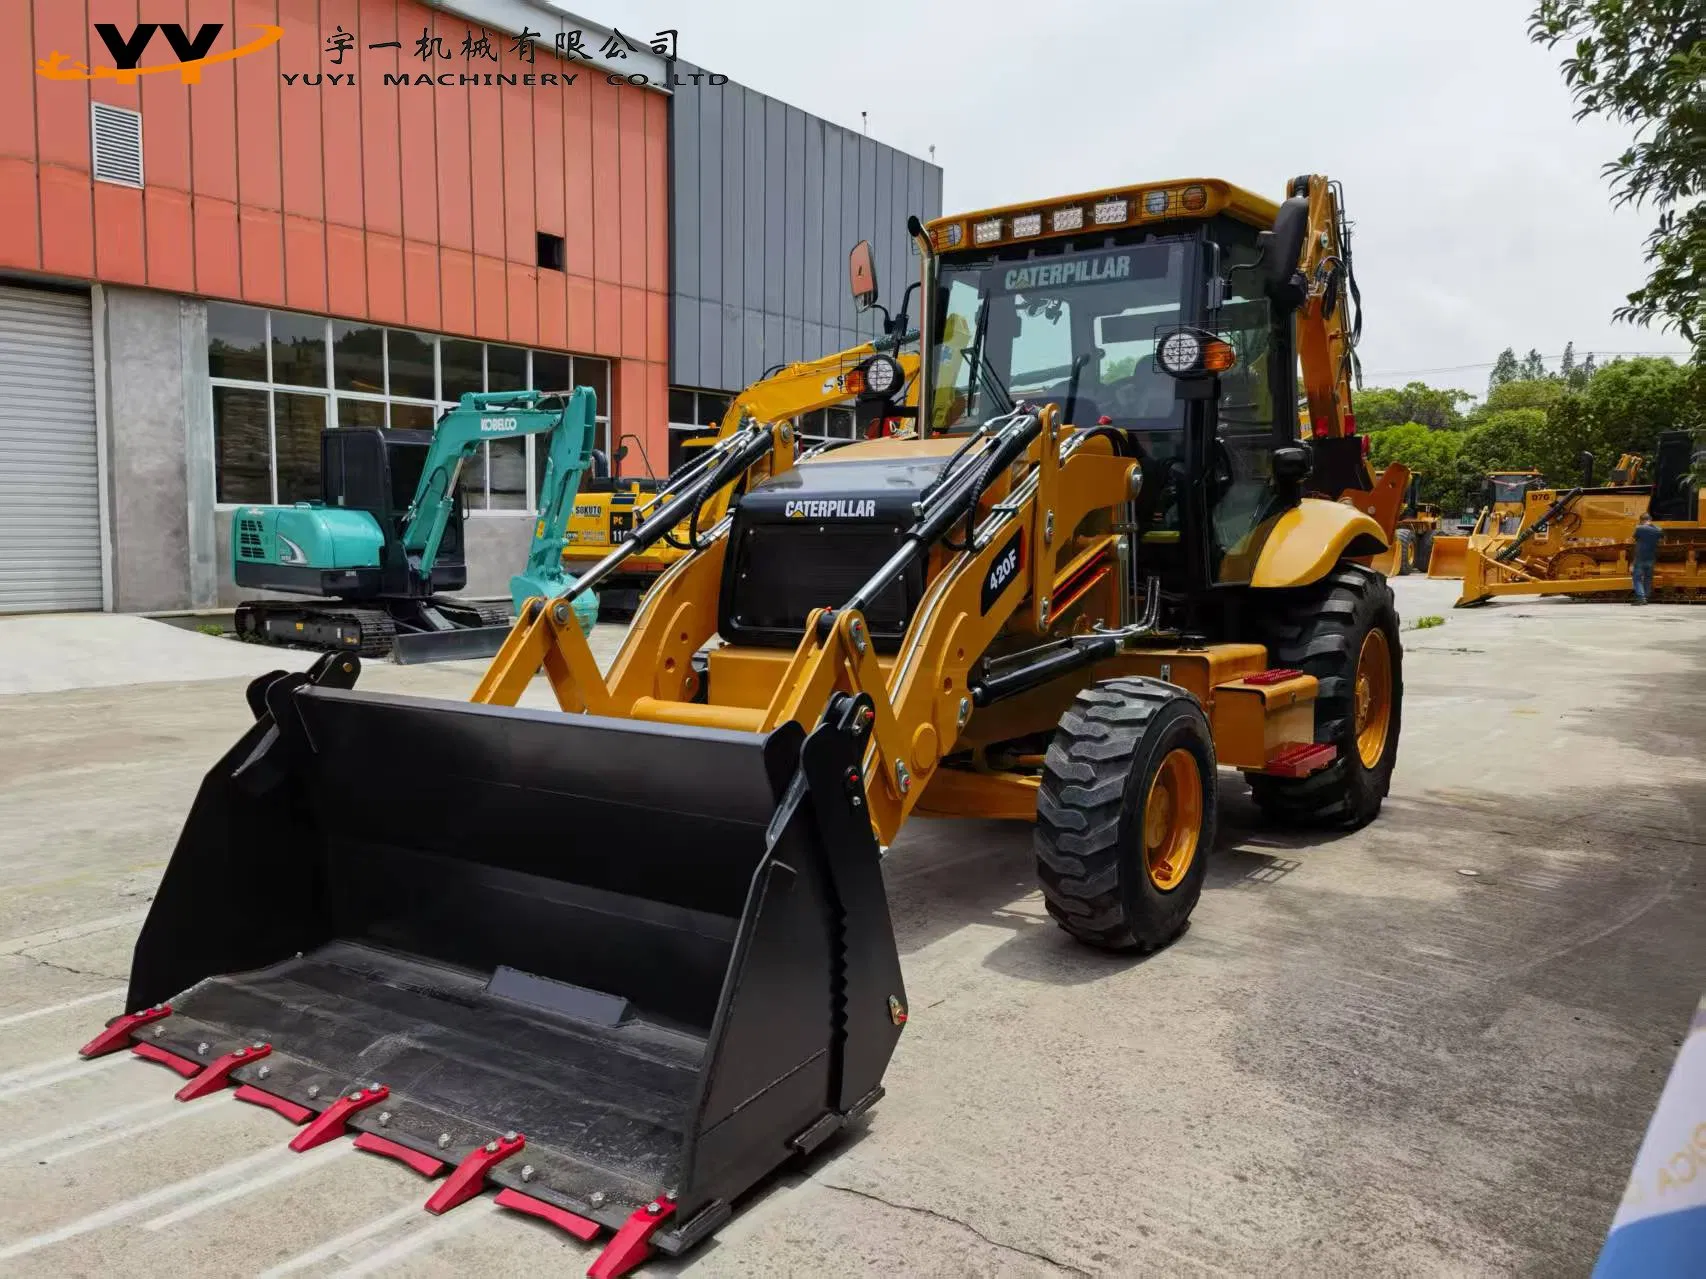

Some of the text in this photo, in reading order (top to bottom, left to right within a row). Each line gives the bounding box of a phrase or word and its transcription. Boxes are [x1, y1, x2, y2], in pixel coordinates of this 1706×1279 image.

[1004, 255, 1130, 290] CATERPILLAR
[481, 417, 517, 431] KOBELCO
[785, 499, 875, 518] CATERPILLAR
[990, 548, 1017, 590] 420F
